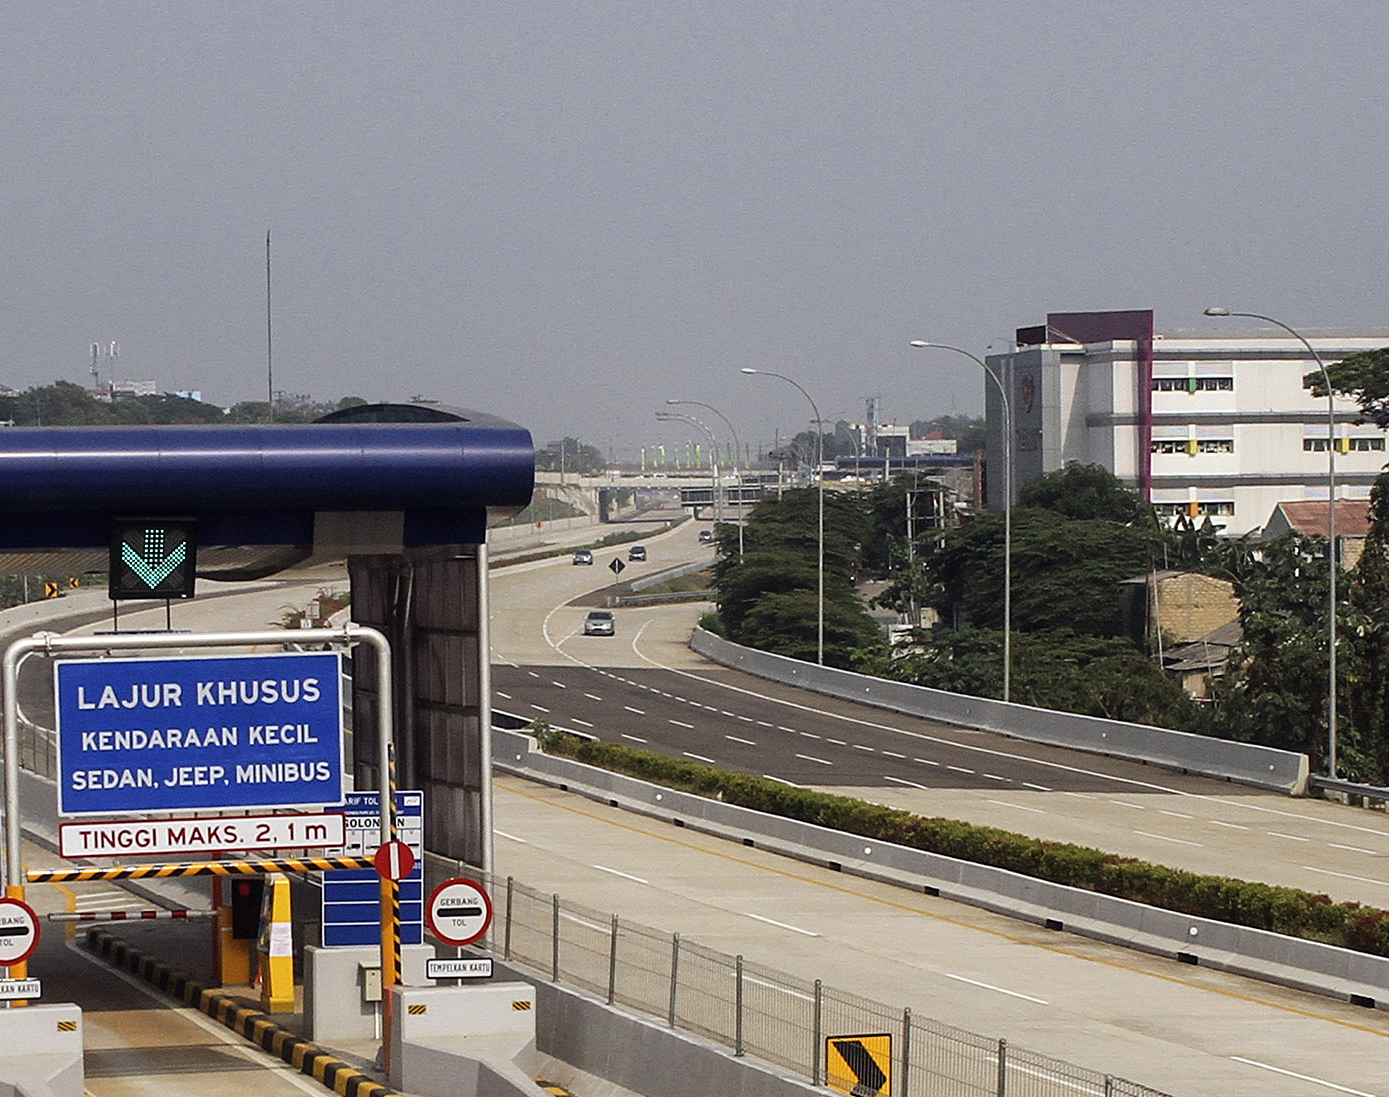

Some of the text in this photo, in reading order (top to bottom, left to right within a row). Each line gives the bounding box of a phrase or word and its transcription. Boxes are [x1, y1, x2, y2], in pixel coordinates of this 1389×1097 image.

[77, 677, 321, 710] LAJUR KHUSUS
[81, 722, 319, 752] KENDARAAN KECIL
[71, 767, 159, 791] SEDAN,
[236, 761, 331, 785] MINIBUS
[79, 828, 157, 851] TINGGI
[167, 825, 245, 848] MAKS.
[440, 897, 479, 906] GERBANG
[452, 918, 467, 927] TOL
[0, 938, 14, 947] TOL
